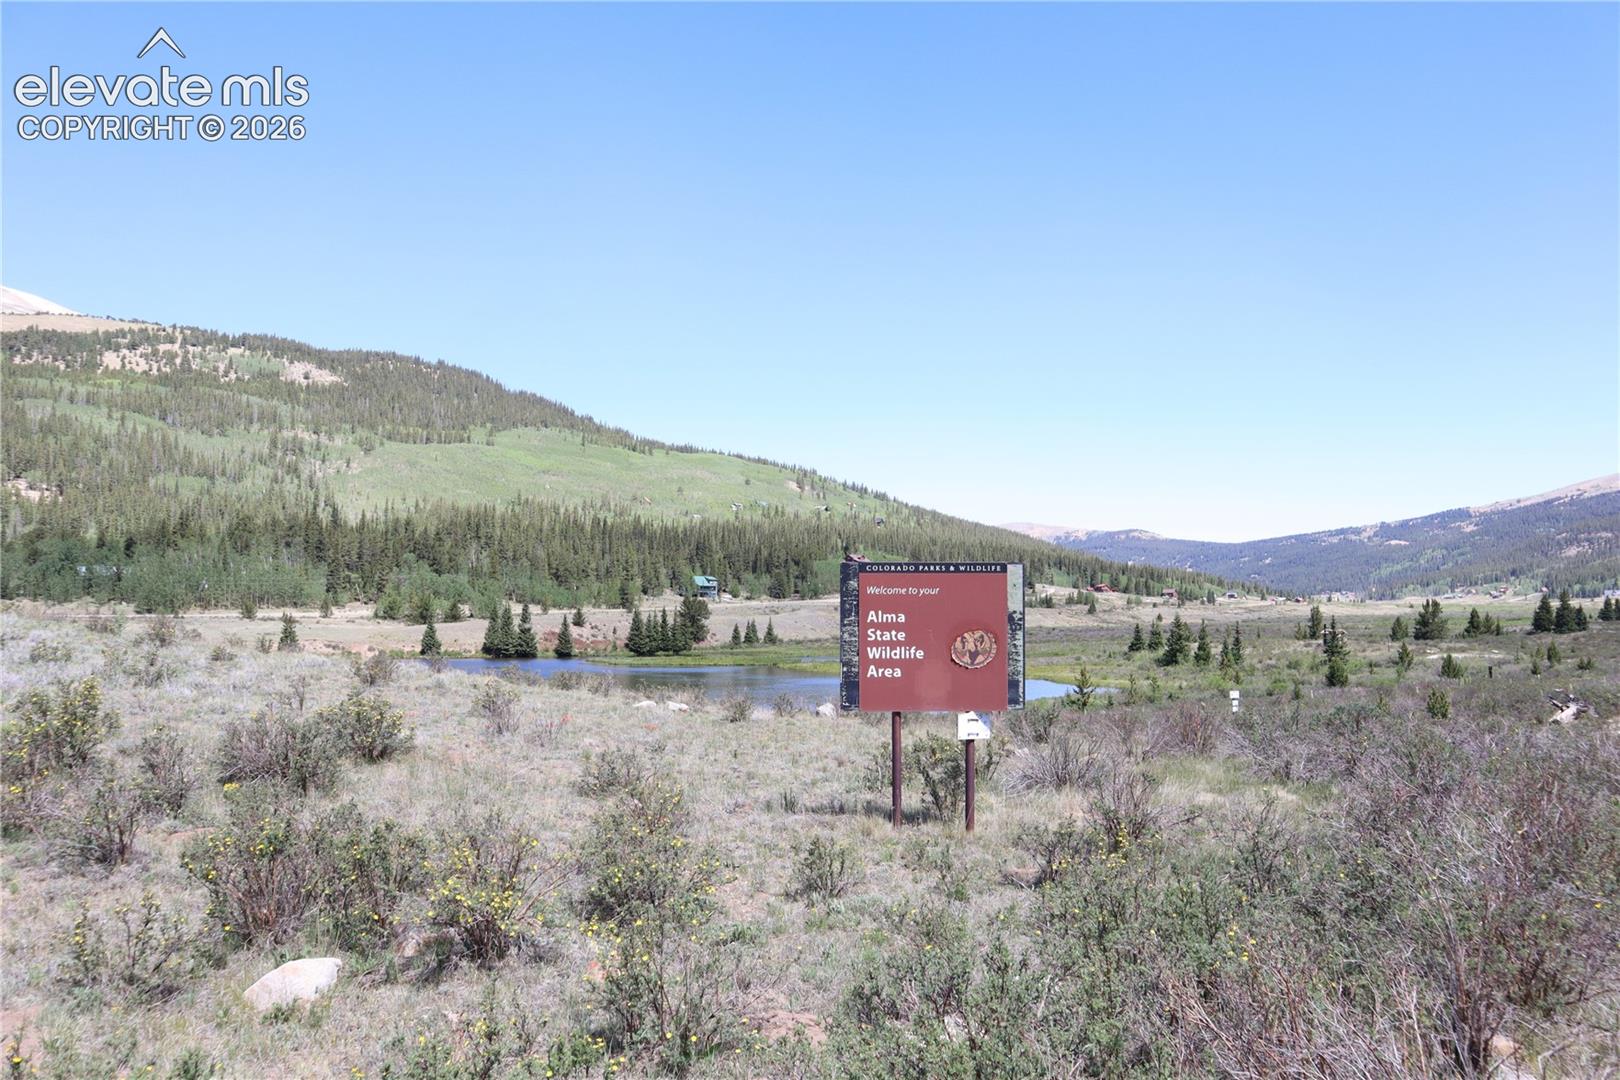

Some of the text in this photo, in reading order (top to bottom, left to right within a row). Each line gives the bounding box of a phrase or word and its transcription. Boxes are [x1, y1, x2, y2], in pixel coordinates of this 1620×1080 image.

[866, 586, 940, 597] Welcome to your
[867, 610, 906, 623] Alma
[867, 628, 906, 641] State
[867, 646, 924, 659] Wildlife
[867, 665, 902, 678] Area
